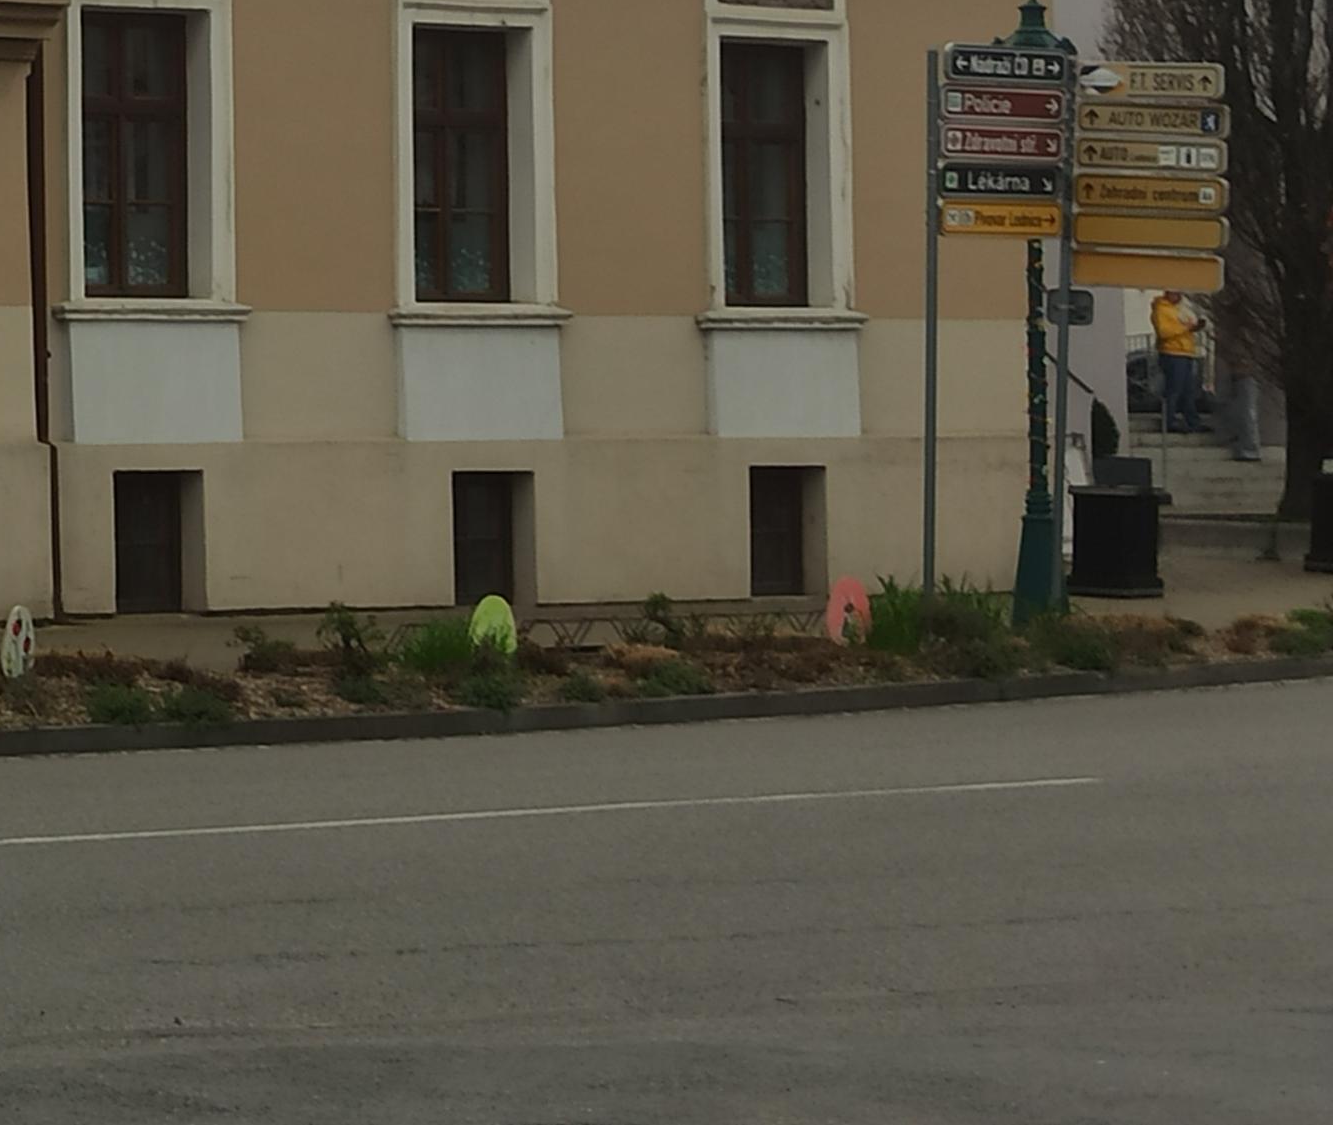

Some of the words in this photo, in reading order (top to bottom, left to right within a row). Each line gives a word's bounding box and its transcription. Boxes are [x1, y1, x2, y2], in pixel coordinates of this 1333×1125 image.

[1153, 73, 1195, 91] SERVIS
[1108, 110, 1143, 126] AUTO
[967, 169, 1030, 191] Lékárna
